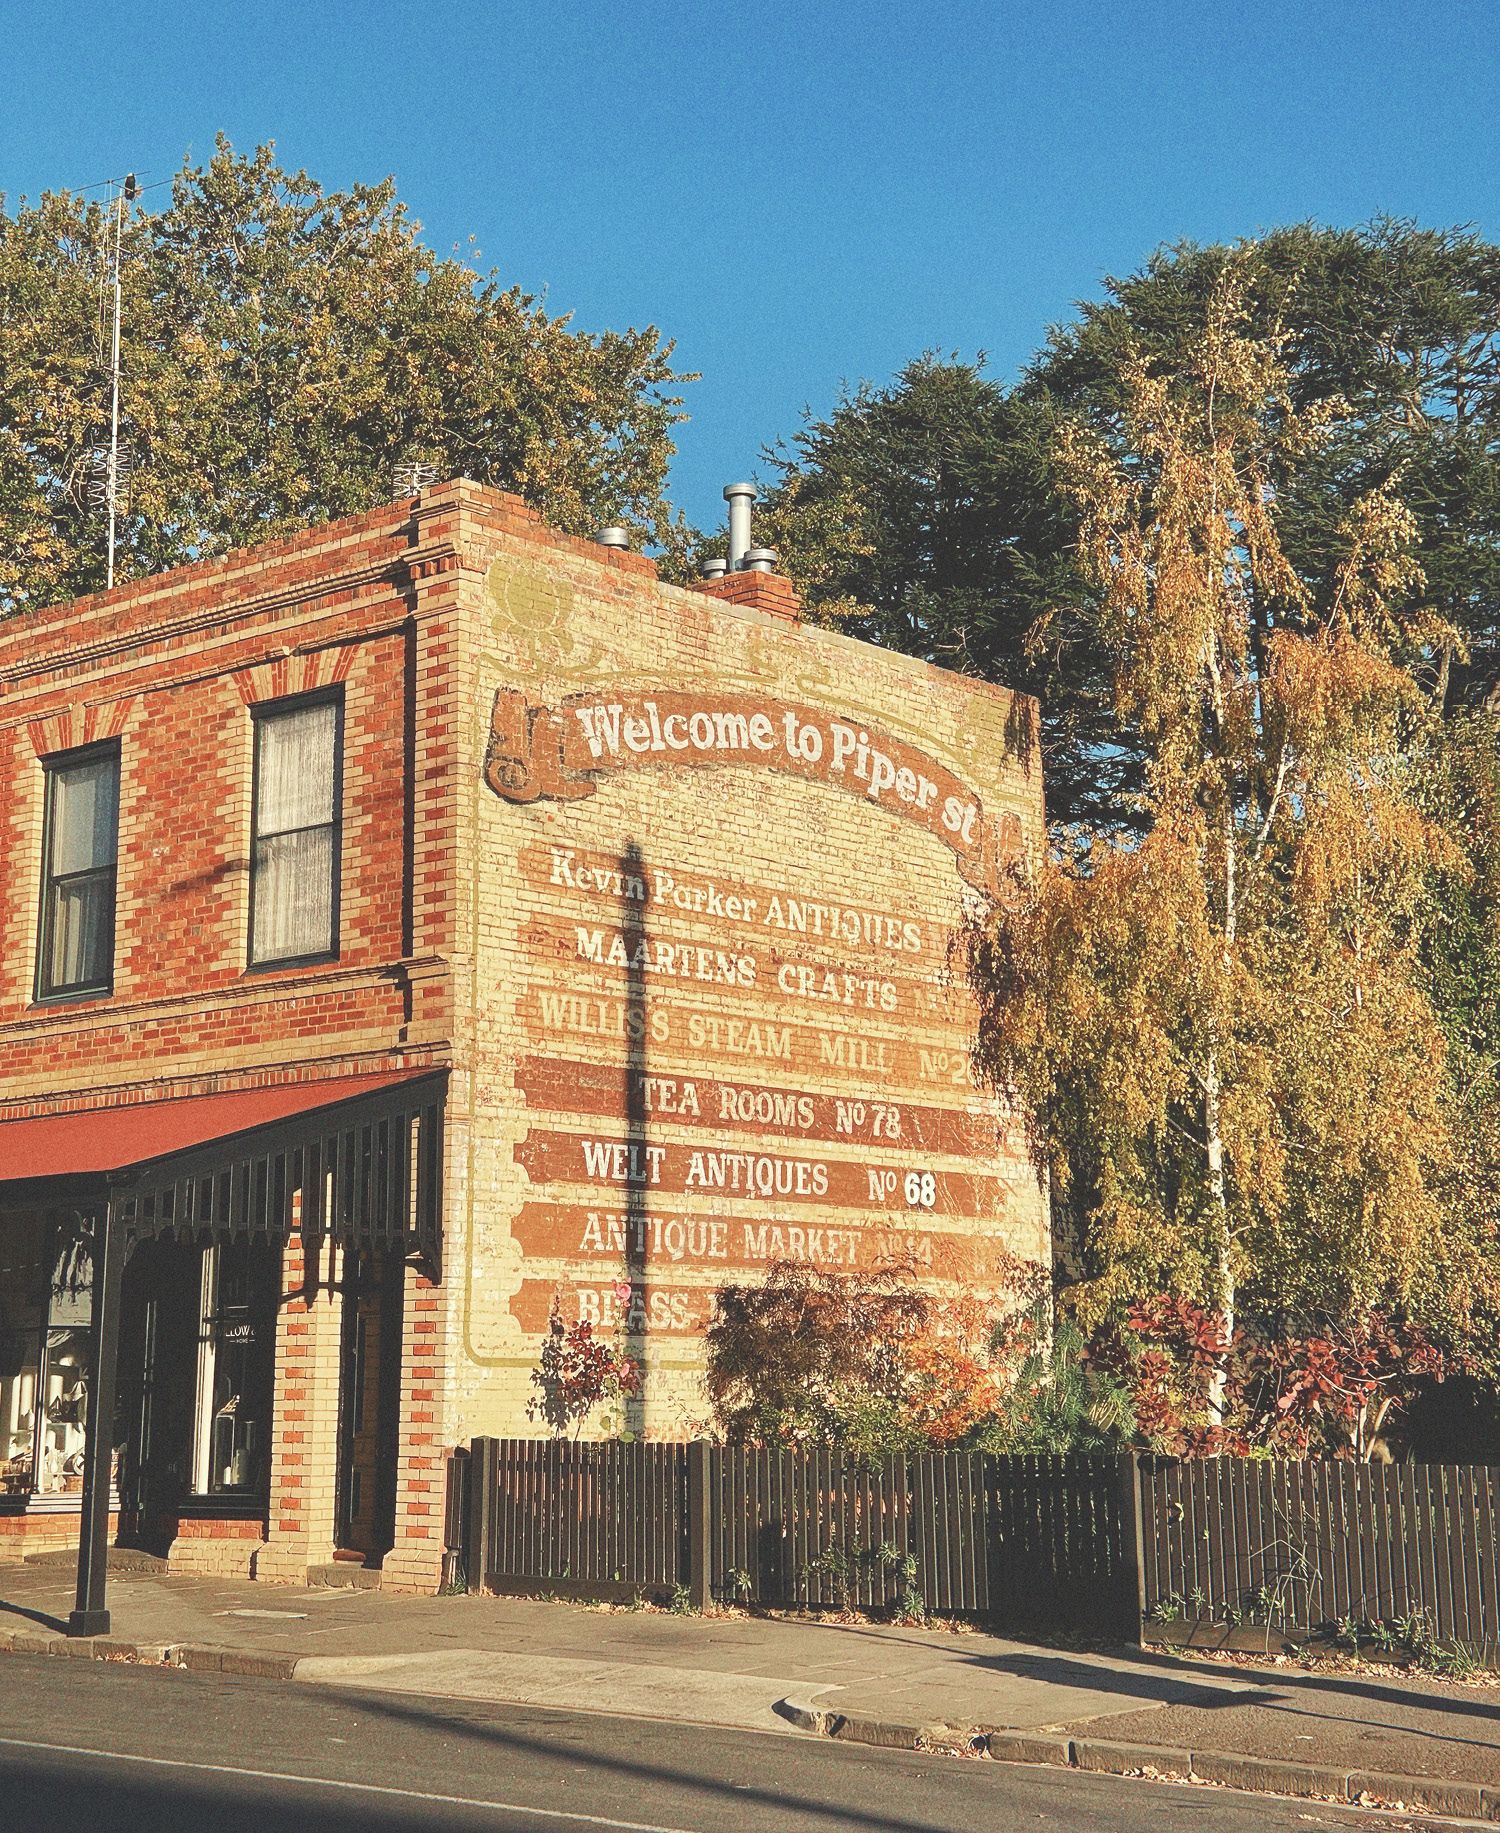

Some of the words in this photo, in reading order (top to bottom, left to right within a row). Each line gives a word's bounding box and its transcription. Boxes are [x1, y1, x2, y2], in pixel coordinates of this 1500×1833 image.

[575, 702, 774, 758] Welcome
[782, 711, 823, 762] to
[830, 723, 938, 810] Piper
[550, 847, 645, 901] Kevin
[652, 869, 757, 922] Parker
[763, 896, 922, 953] ANTIQUES
[575, 926, 757, 987] MAARTENS
[777, 964, 898, 1012] CRAFTS
[688, 1014, 792, 1060] STEAM
[818, 1032, 894, 1074] MILL
[639, 1076, 701, 1115] TEA
[718, 1085, 814, 1129] ROOMS
[871, 1104, 902, 1139] 78
[581, 1140, 666, 1184] WELT
[685, 1152, 829, 1197] ANTIQUES
[904, 1172, 936, 1207] 68
[579, 1212, 728, 1260] ANTIQUE
[742, 1223, 862, 1264] MARKET
